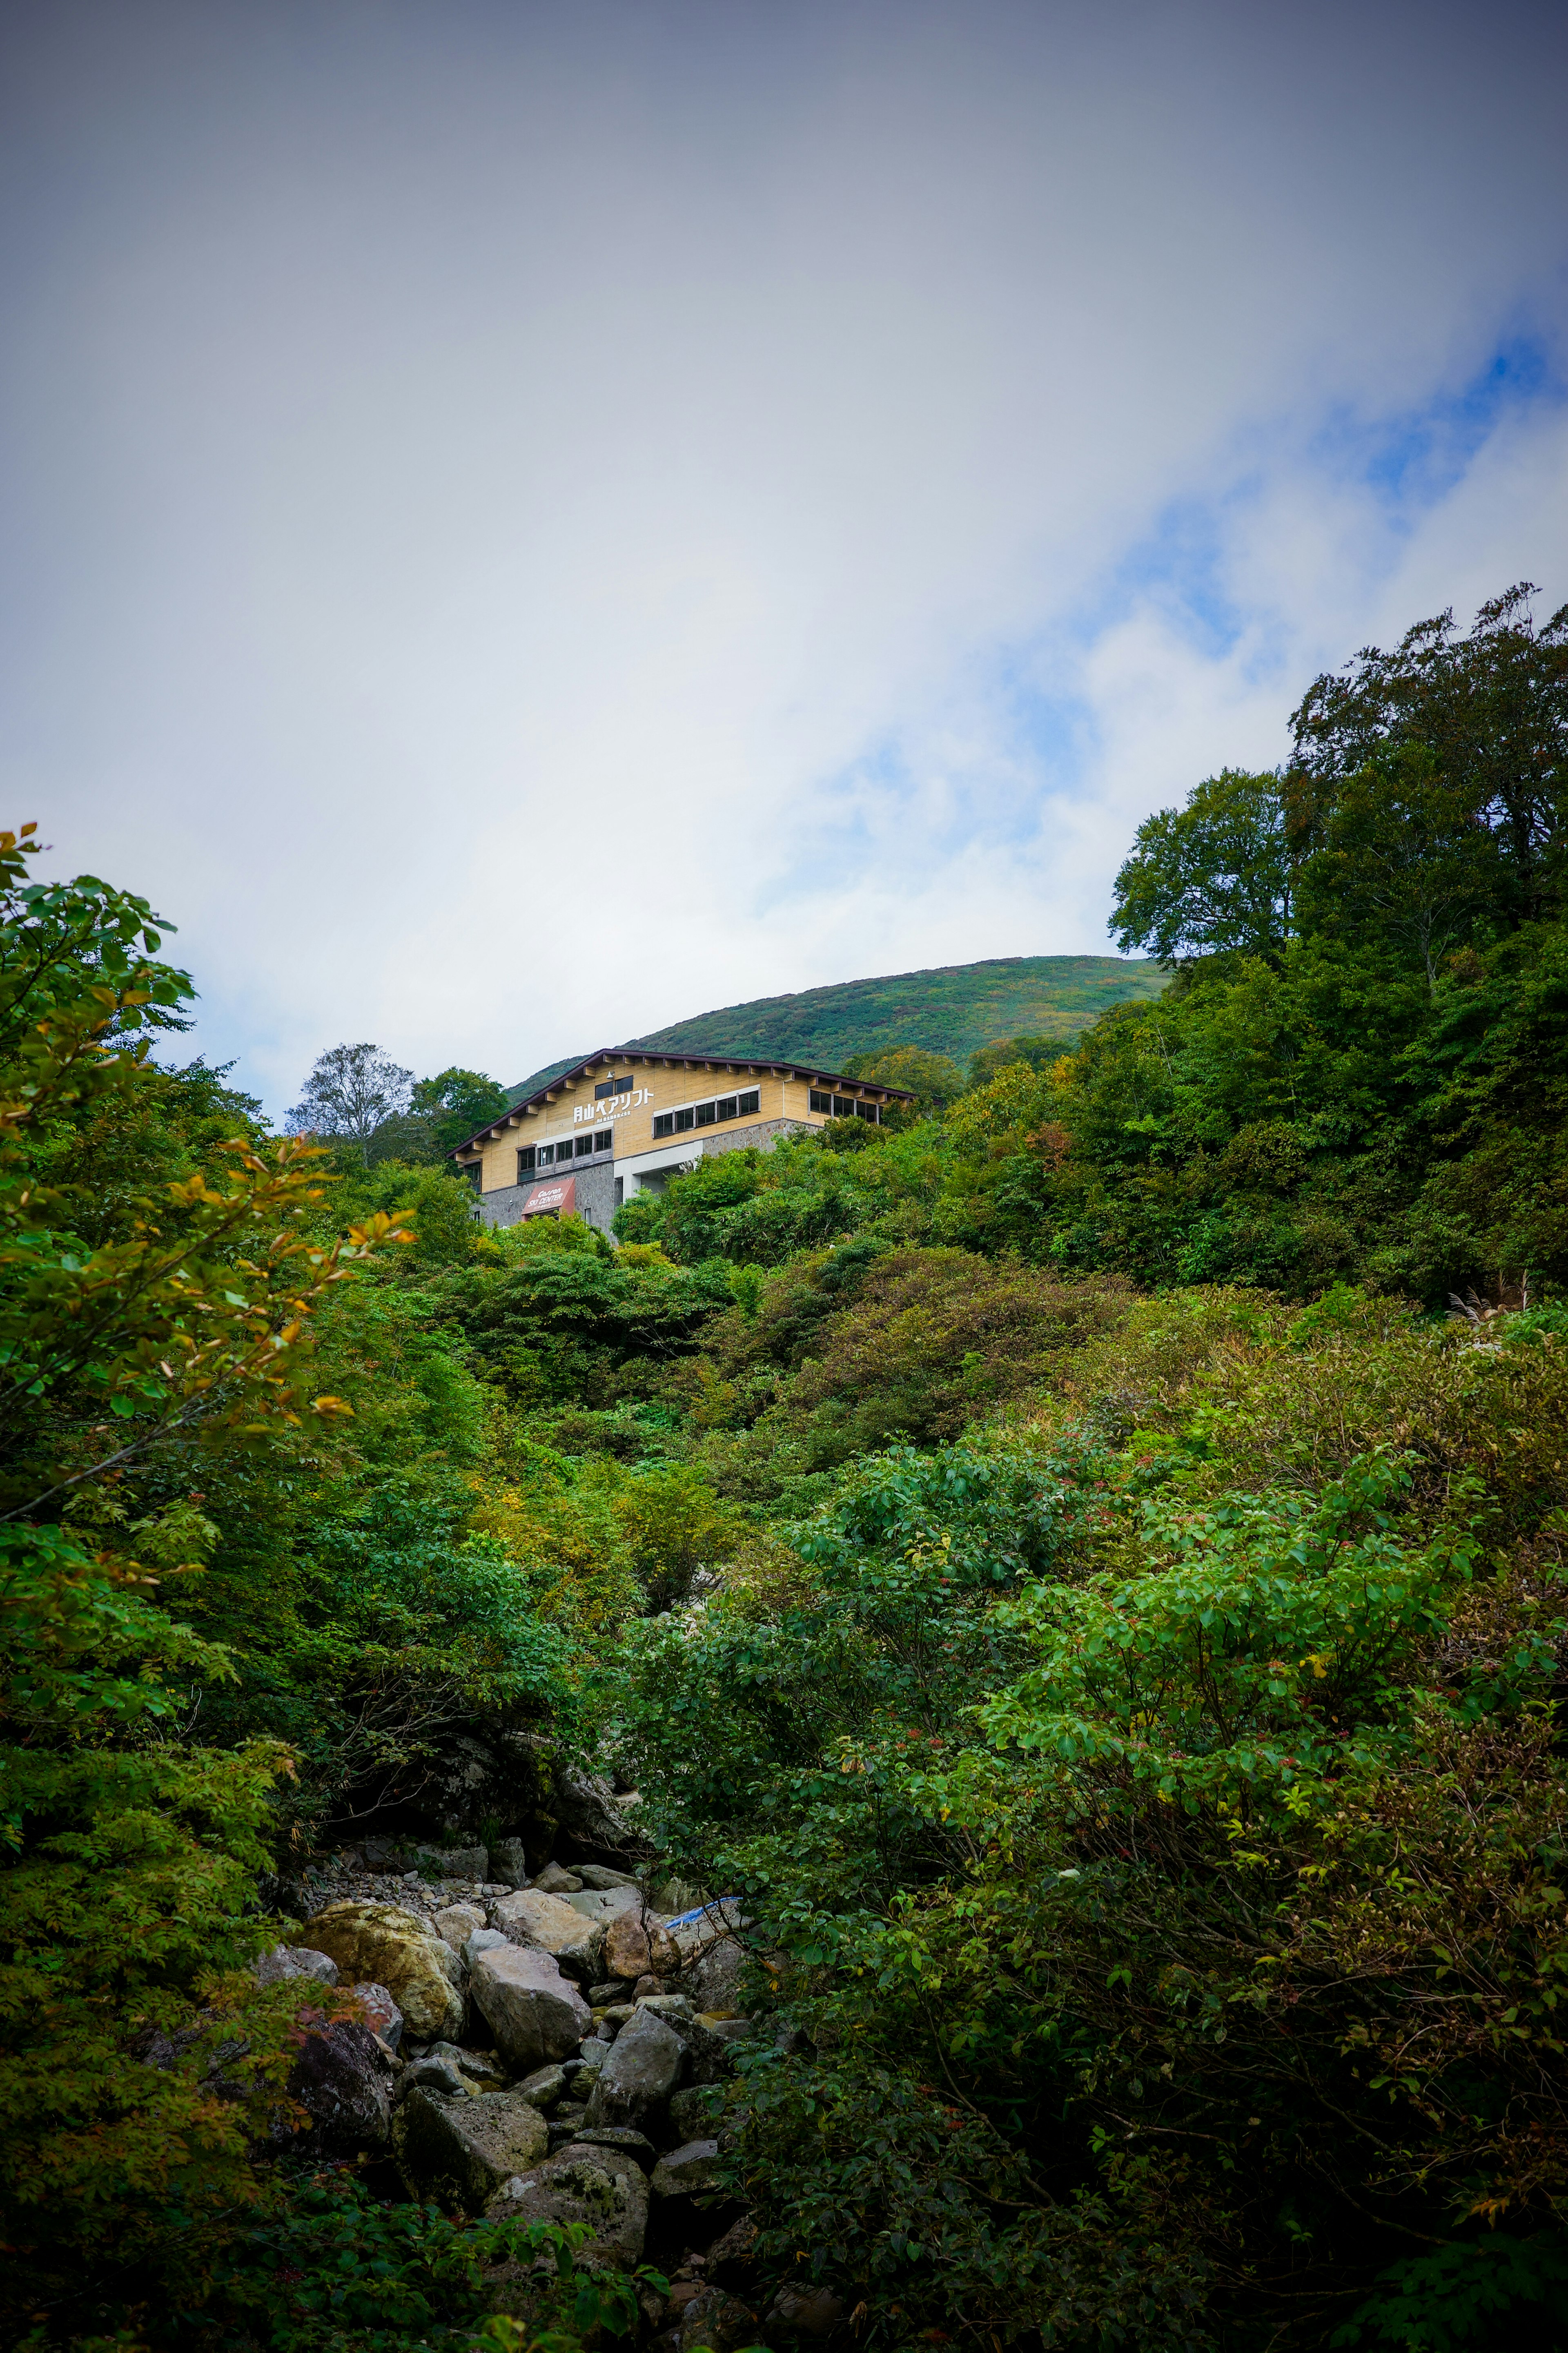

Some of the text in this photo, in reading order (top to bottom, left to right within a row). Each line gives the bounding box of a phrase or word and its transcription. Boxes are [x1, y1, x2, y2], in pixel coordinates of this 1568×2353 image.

[574, 1088, 654, 1123] 月山ペアリフト
[528, 1199, 539, 1207] SKI
[539, 1193, 563, 1204] CENTER
